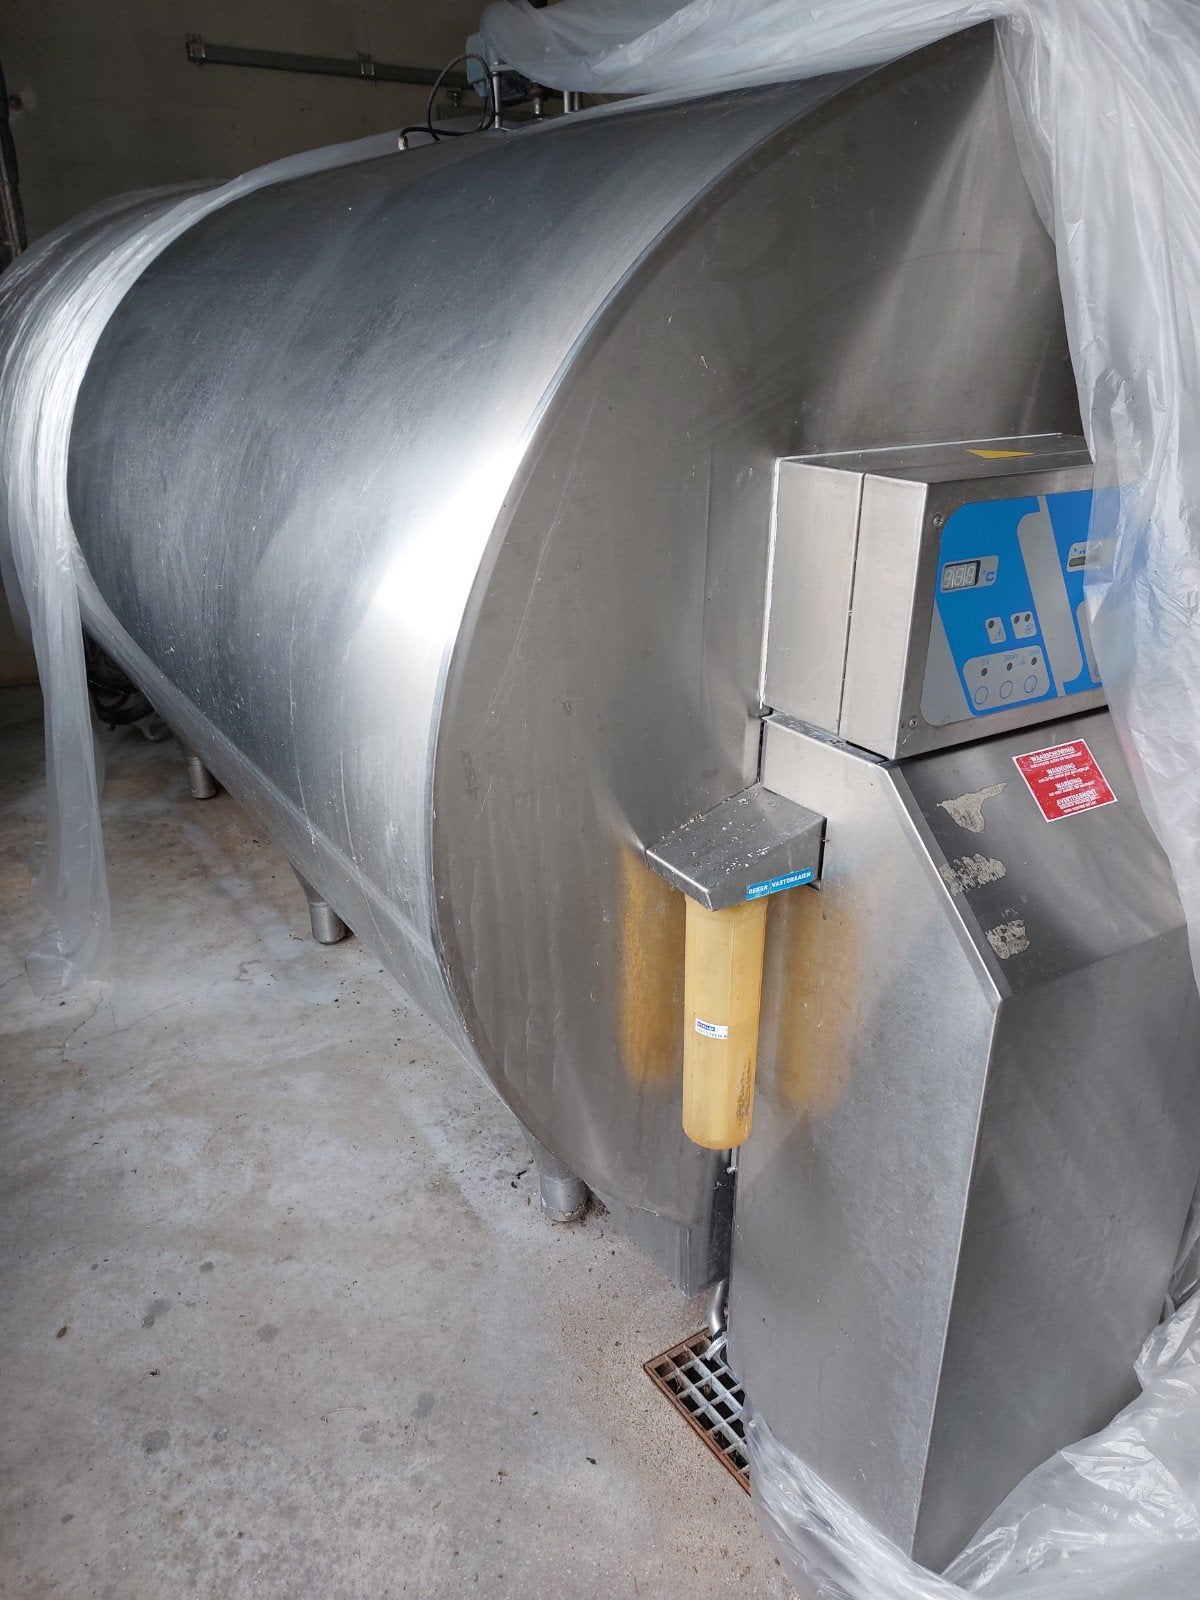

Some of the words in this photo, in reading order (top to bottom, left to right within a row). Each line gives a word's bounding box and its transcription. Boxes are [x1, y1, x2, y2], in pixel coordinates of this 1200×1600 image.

[1030, 746, 1075, 762] WAARSCHUWING
[1046, 762, 1076, 775] WARNUNG
[1055, 777, 1083, 790] WARNING
[1056, 789, 1097, 806] AVERTISSEMENT
[748, 884, 768, 895] BEKER
[771, 871, 811, 888] VASTDRAAIEN
